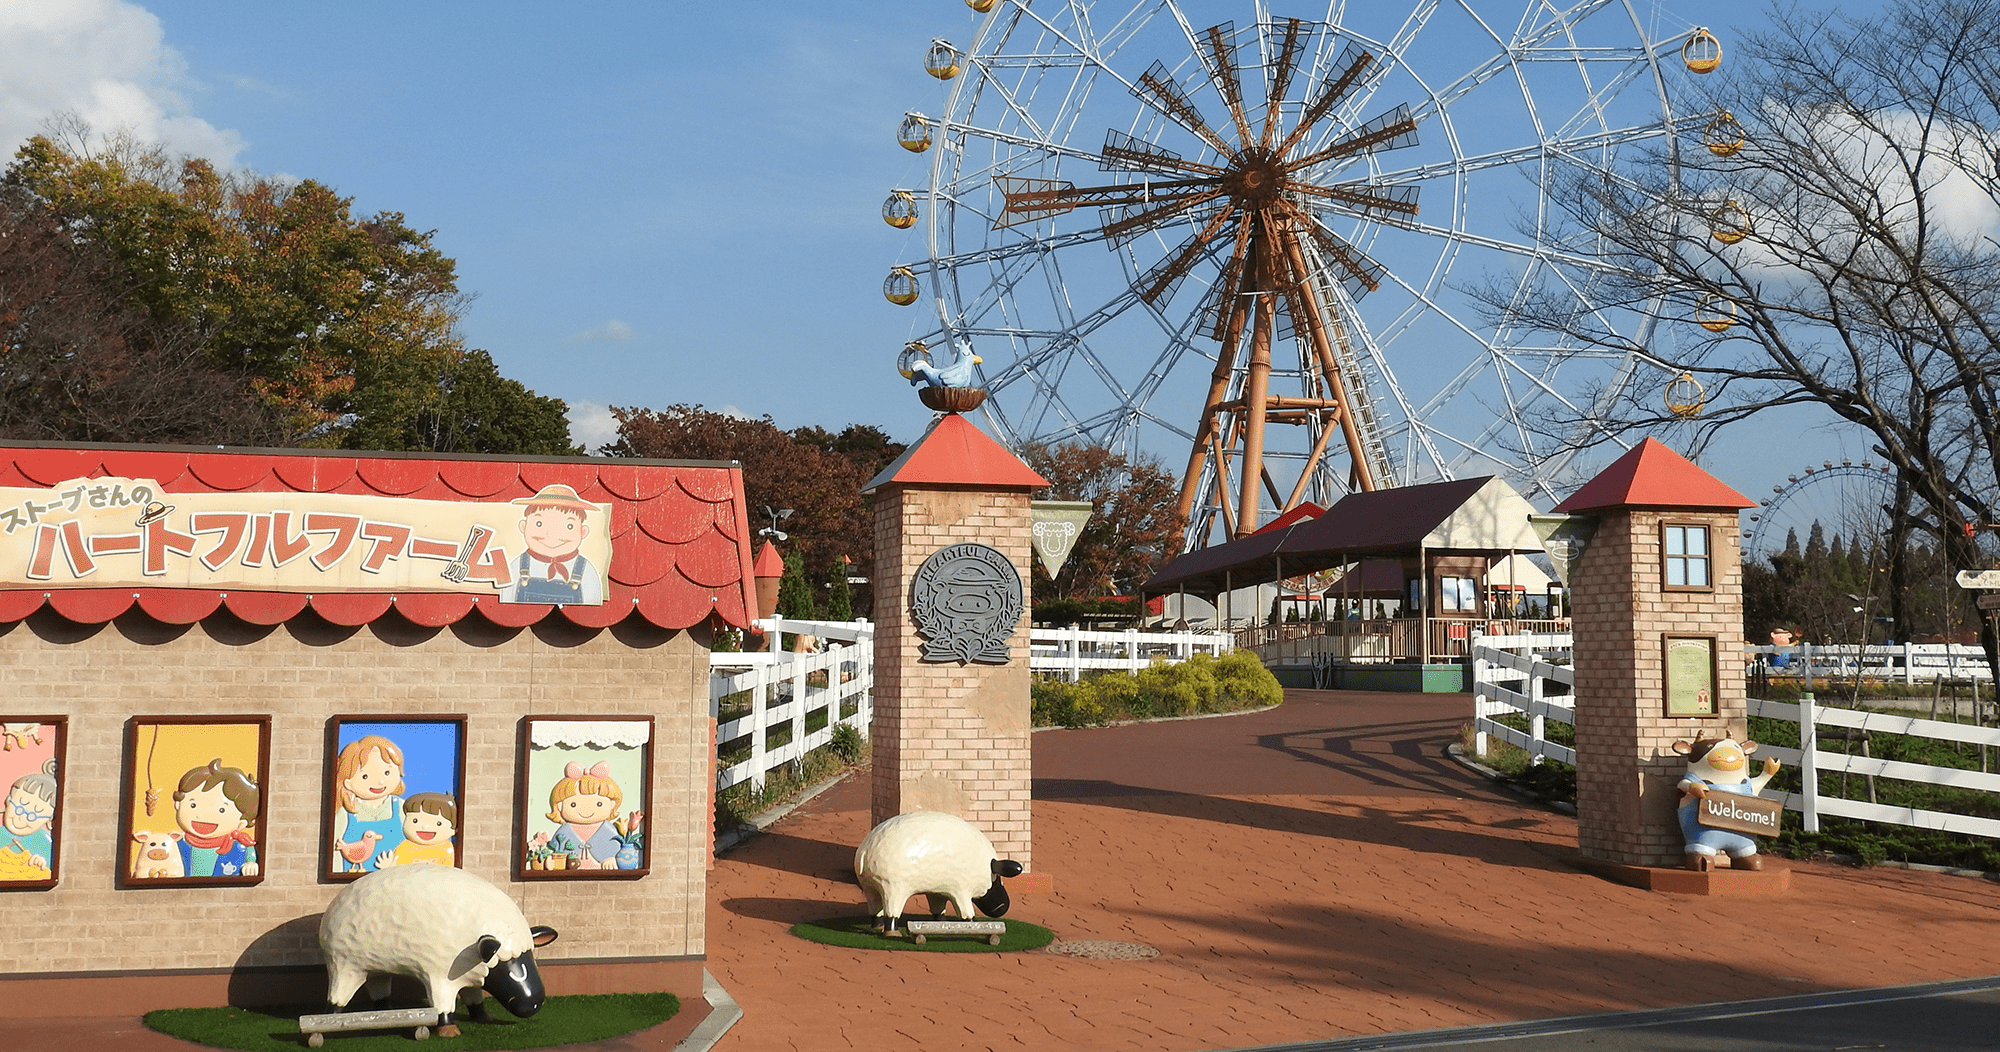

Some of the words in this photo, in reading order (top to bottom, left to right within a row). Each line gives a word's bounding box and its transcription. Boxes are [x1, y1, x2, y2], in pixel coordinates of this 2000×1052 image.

[0, 485, 153, 533] ストーブさんの
[27, 511, 513, 588] ハートフルファーム
[920, 546, 982, 582] HEARTFUL
[1707, 799, 1775, 827] Welcome!
